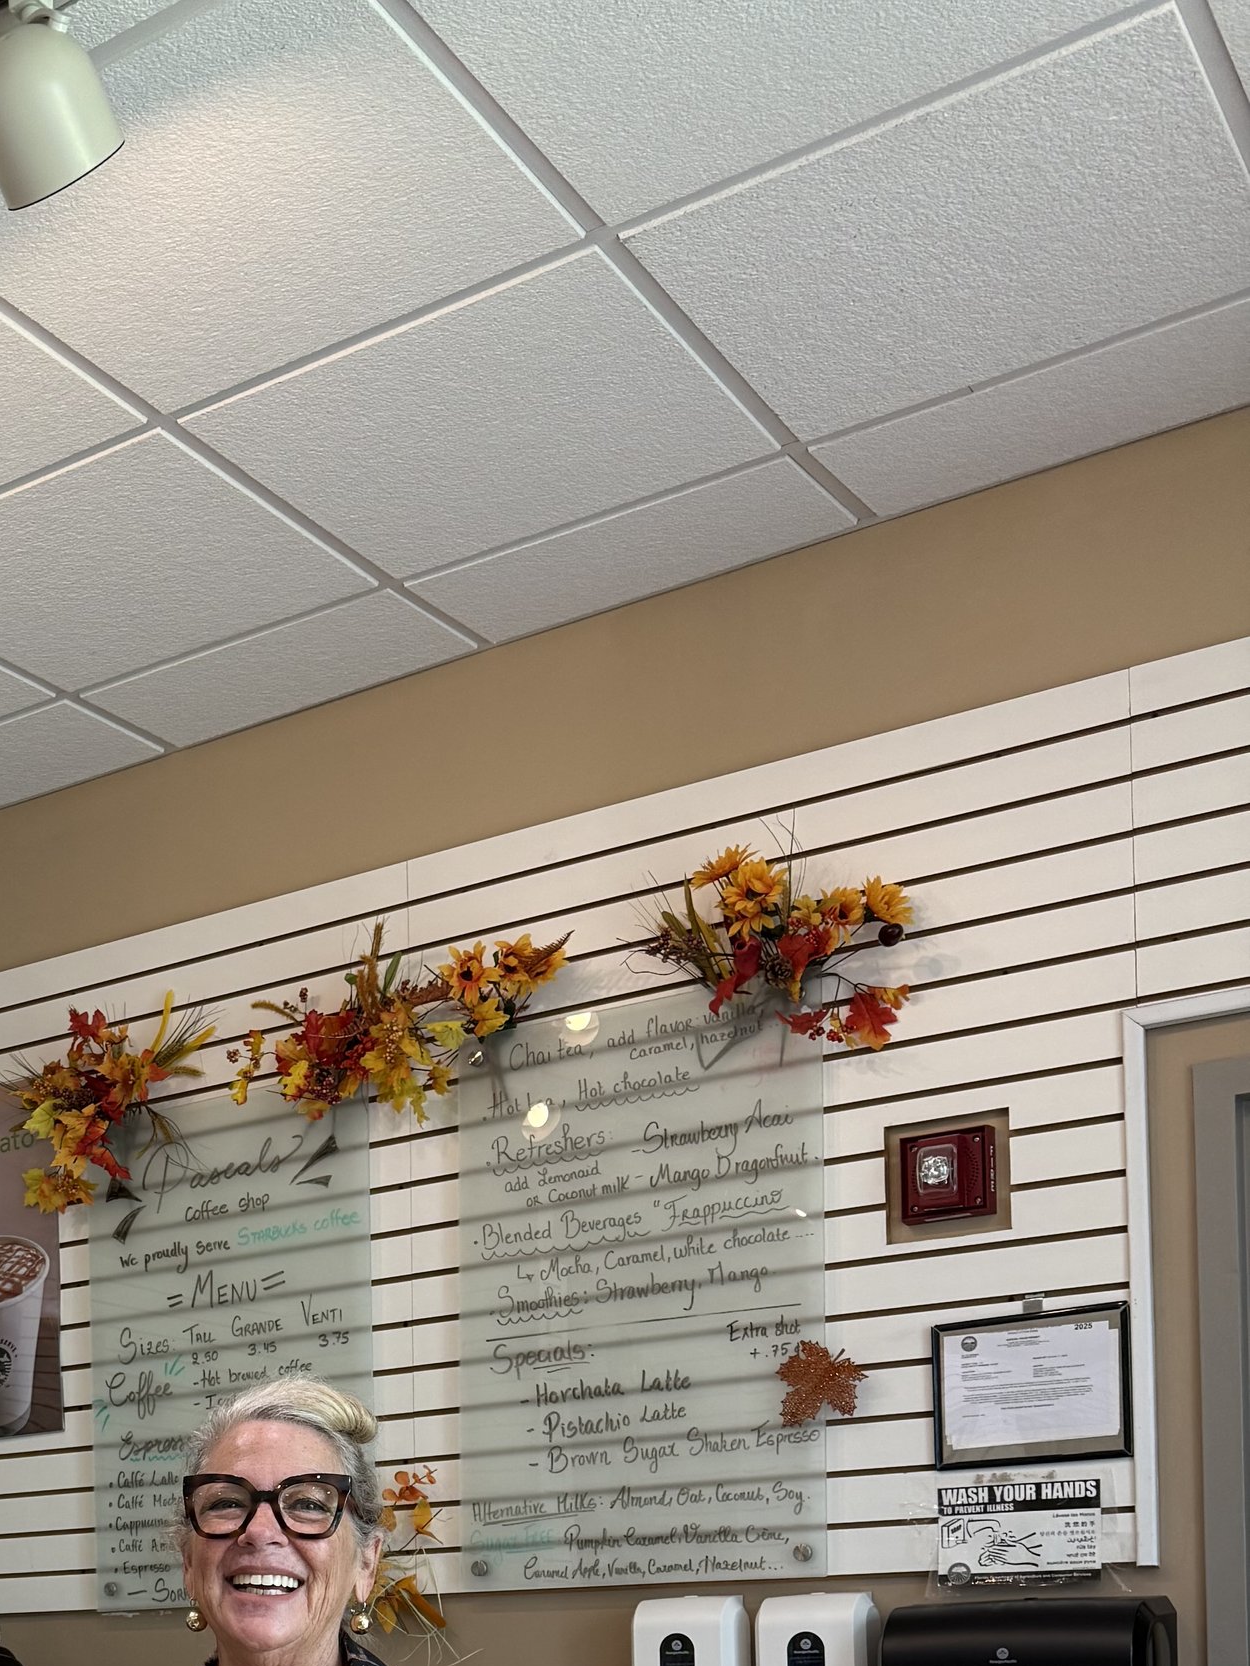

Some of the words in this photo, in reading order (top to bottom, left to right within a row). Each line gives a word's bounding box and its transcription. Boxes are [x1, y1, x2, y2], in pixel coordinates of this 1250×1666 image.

[606, 1026, 635, 1049] add
[578, 1078, 606, 1101] Hot
[613, 1066, 691, 1093] chocolate
[744, 1099, 794, 1128] Acai
[505, 1174, 530, 1193] add
[650, 1165, 709, 1192] Mango
[548, 1184, 598, 1205] Coconut
[120, 1253, 138, 1269] We
[144, 1241, 189, 1274] proudly
[314, 1208, 362, 1231] coffee
[483, 1223, 552, 1250] Blended
[561, 1210, 642, 1239] Beverages
[604, 1244, 671, 1270] Caramel,
[674, 1239, 717, 1260] white
[724, 1228, 791, 1251] chocolate
[231, 1315, 284, 1338] GRANDE
[300, 1293, 344, 1326] VENTI
[727, 1321, 769, 1342] Extra
[775, 1317, 801, 1339] shot
[1074, 1322, 1093, 1331] 2025
[192, 1350, 219, 1366] 2.50
[247, 1341, 277, 1356] 3.45
[318, 1331, 350, 1348] 3.75
[105, 1369, 173, 1420] Coffee
[228, 1362, 270, 1382] brewed
[278, 1358, 313, 1377] coffee
[535, 1378, 625, 1407] Horchata
[641, 1369, 692, 1391] Latte
[543, 1410, 631, 1442] Pistachio
[640, 1402, 687, 1424] Latte
[548, 1445, 611, 1474] Brown
[623, 1436, 680, 1473] Sugar
[686, 1427, 750, 1456] Shaken
[752, 1420, 821, 1455] Espresso
[941, 1487, 989, 1506] WASH
[993, 1484, 1037, 1503] YOUR
[1040, 1480, 1098, 1501] HANDS
[472, 1499, 547, 1524] Alternative
[943, 1506, 953, 1515] TO
[955, 1504, 985, 1514] PREVENT
[987, 1503, 1015, 1513] ILLNESS
[565, 1524, 623, 1554] Pumpkin
[123, 1560, 171, 1579] Espresso
